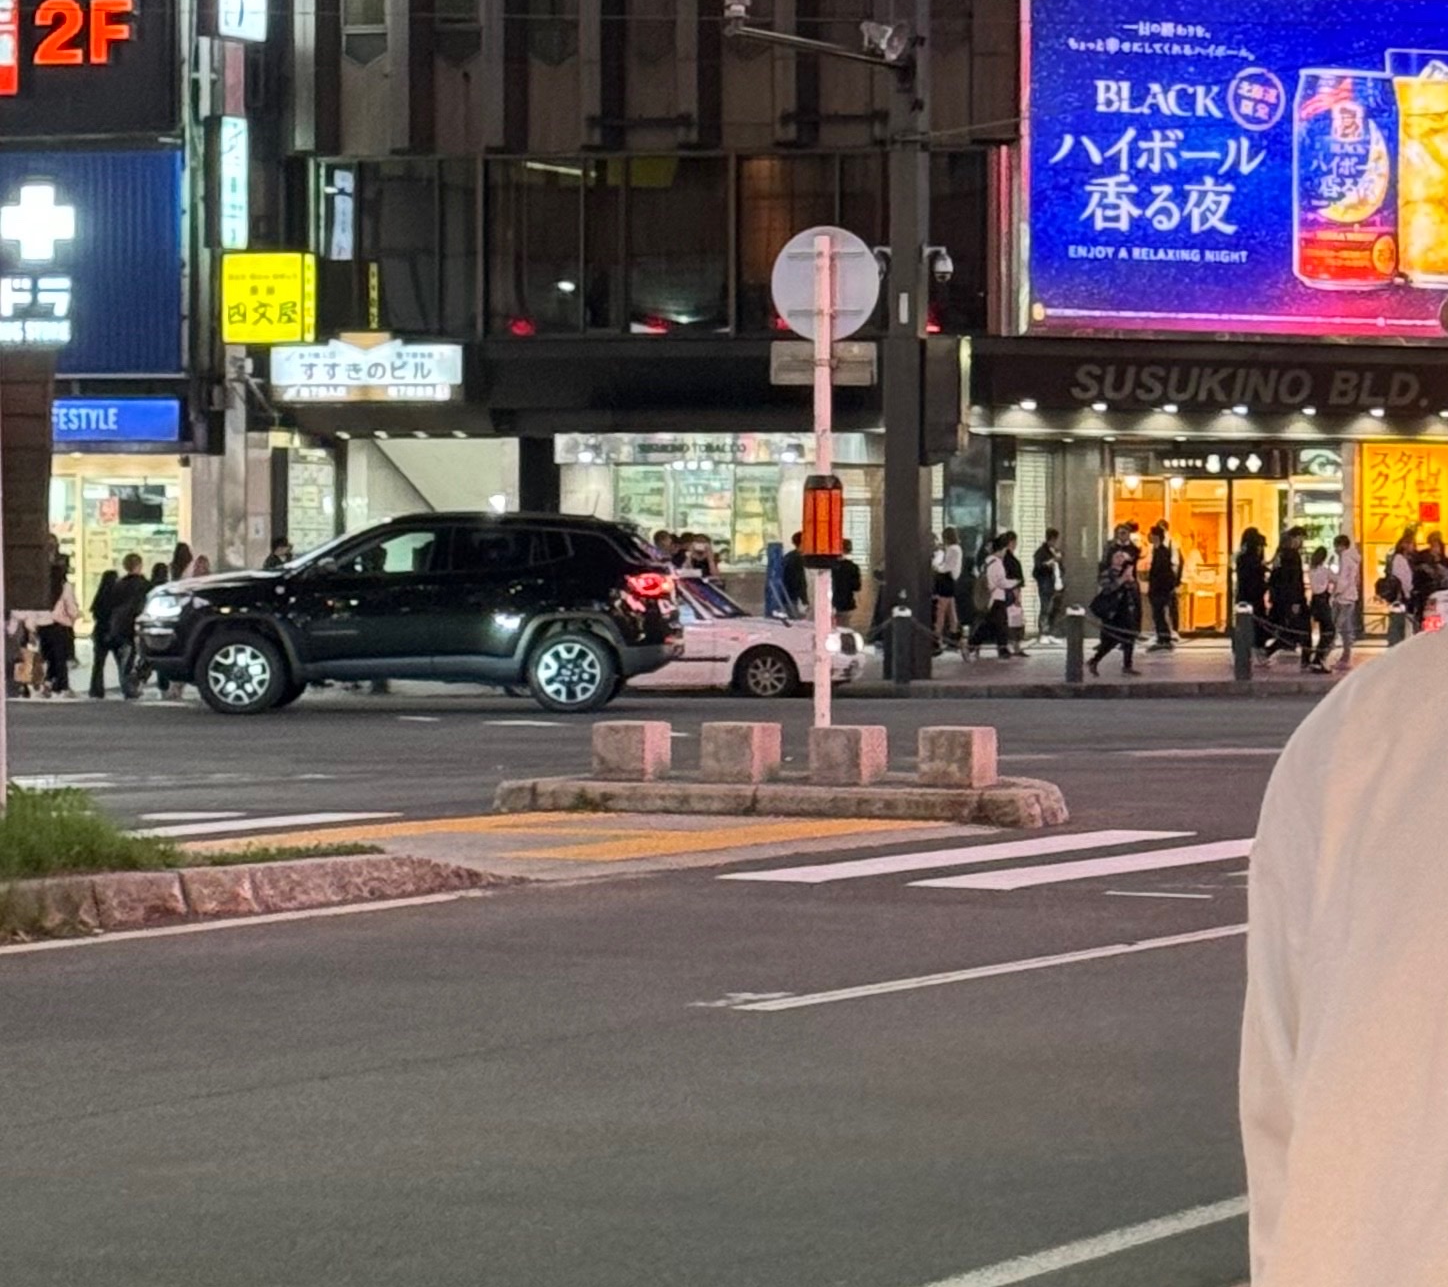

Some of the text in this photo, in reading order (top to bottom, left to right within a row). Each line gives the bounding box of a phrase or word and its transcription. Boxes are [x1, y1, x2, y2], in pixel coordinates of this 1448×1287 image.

[1094, 80, 1223, 118] BLACK
[1049, 128, 1266, 176] ハイボール
[1080, 173, 1238, 234] 香る夜
[1068, 245, 1248, 264] ENJOY A RELAXING NIGHT
[300, 362, 432, 381] すすきのビル
[1070, 363, 1430, 408] SUSUKINO BLD.
[1370, 452, 1390, 533] スクエア
